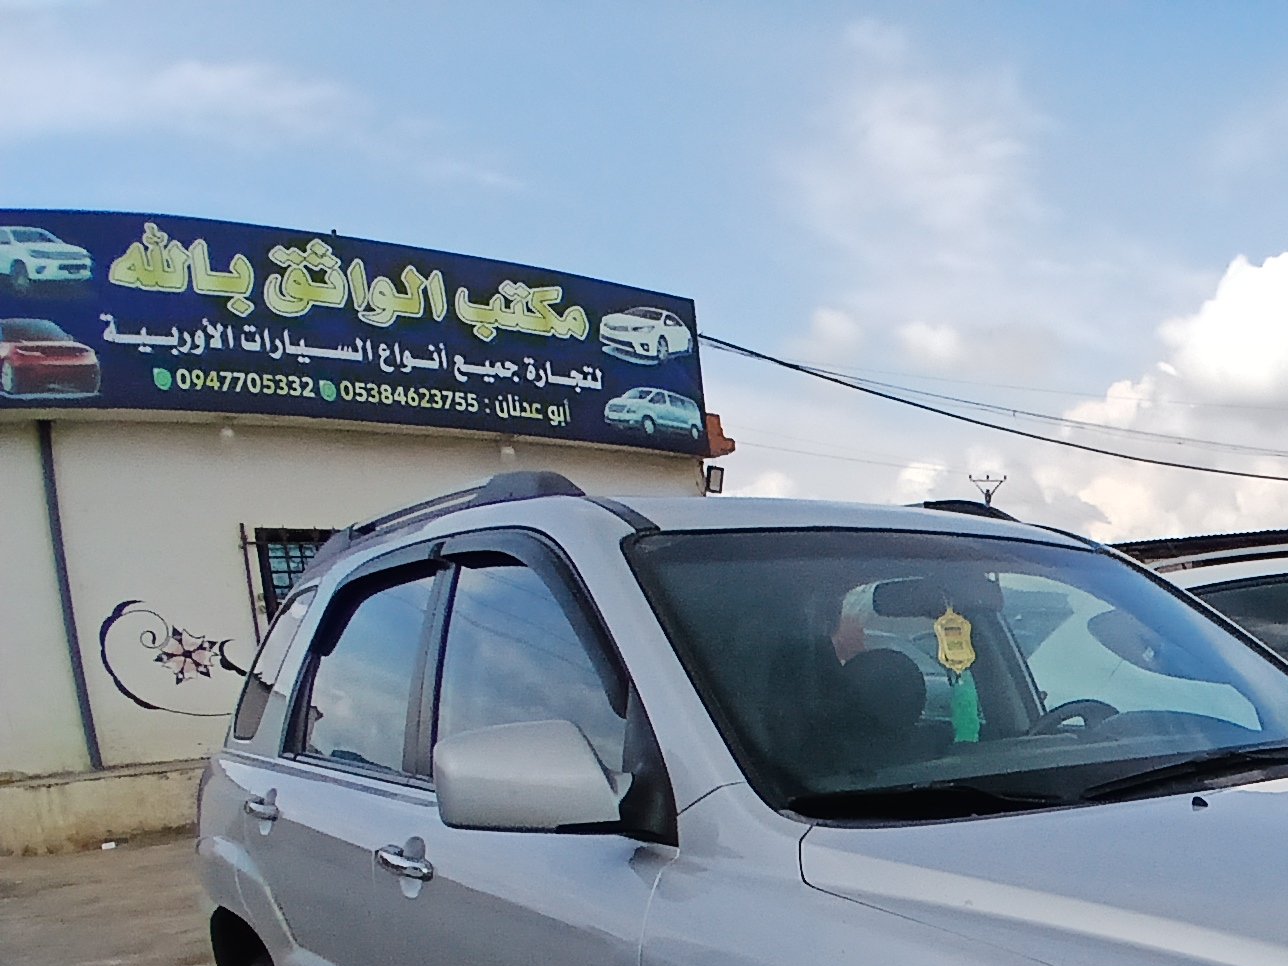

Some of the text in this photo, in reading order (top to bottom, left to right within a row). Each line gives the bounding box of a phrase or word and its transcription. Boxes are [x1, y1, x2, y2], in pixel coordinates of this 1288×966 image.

[109, 222, 590, 341] مكتب الواثق بالله
[99, 313, 603, 393] لتجارة جميع أنواع السيارات الأوربية
[175, 368, 316, 398] 0947705332
[339, 380, 480, 413] 05384623755
[495, 394, 544, 419] عدنان
